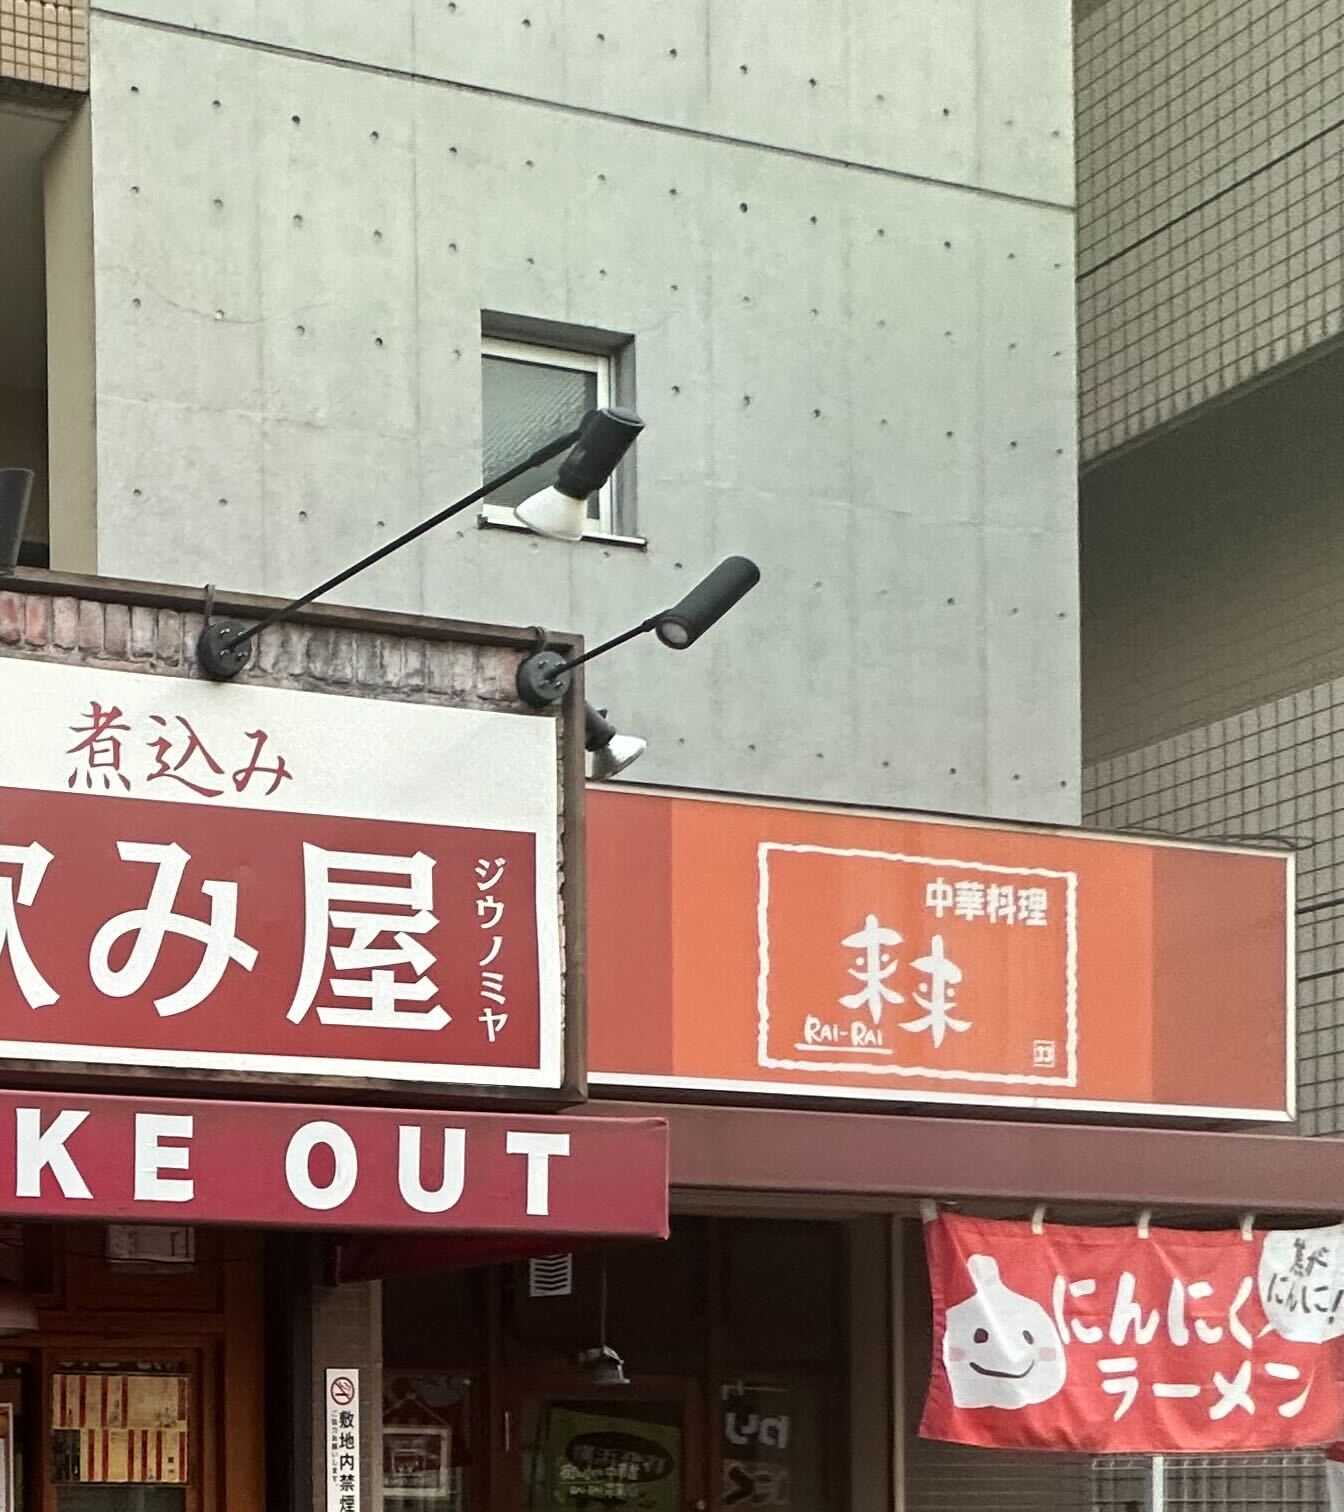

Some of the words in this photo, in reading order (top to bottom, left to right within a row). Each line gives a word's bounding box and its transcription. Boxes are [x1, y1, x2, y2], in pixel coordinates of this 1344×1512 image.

[66, 700, 296, 798] 煮込み
[473, 855, 509, 1043] ジウノミヤ
[925, 877, 1049, 927] 中華料理
[285, 1119, 570, 1218] OUT
[1053, 1271, 1254, 1350] にんにく
[1097, 1359, 1315, 1422] ラーメン
[339, 1411, 355, 1512] 敷地内禁煙
